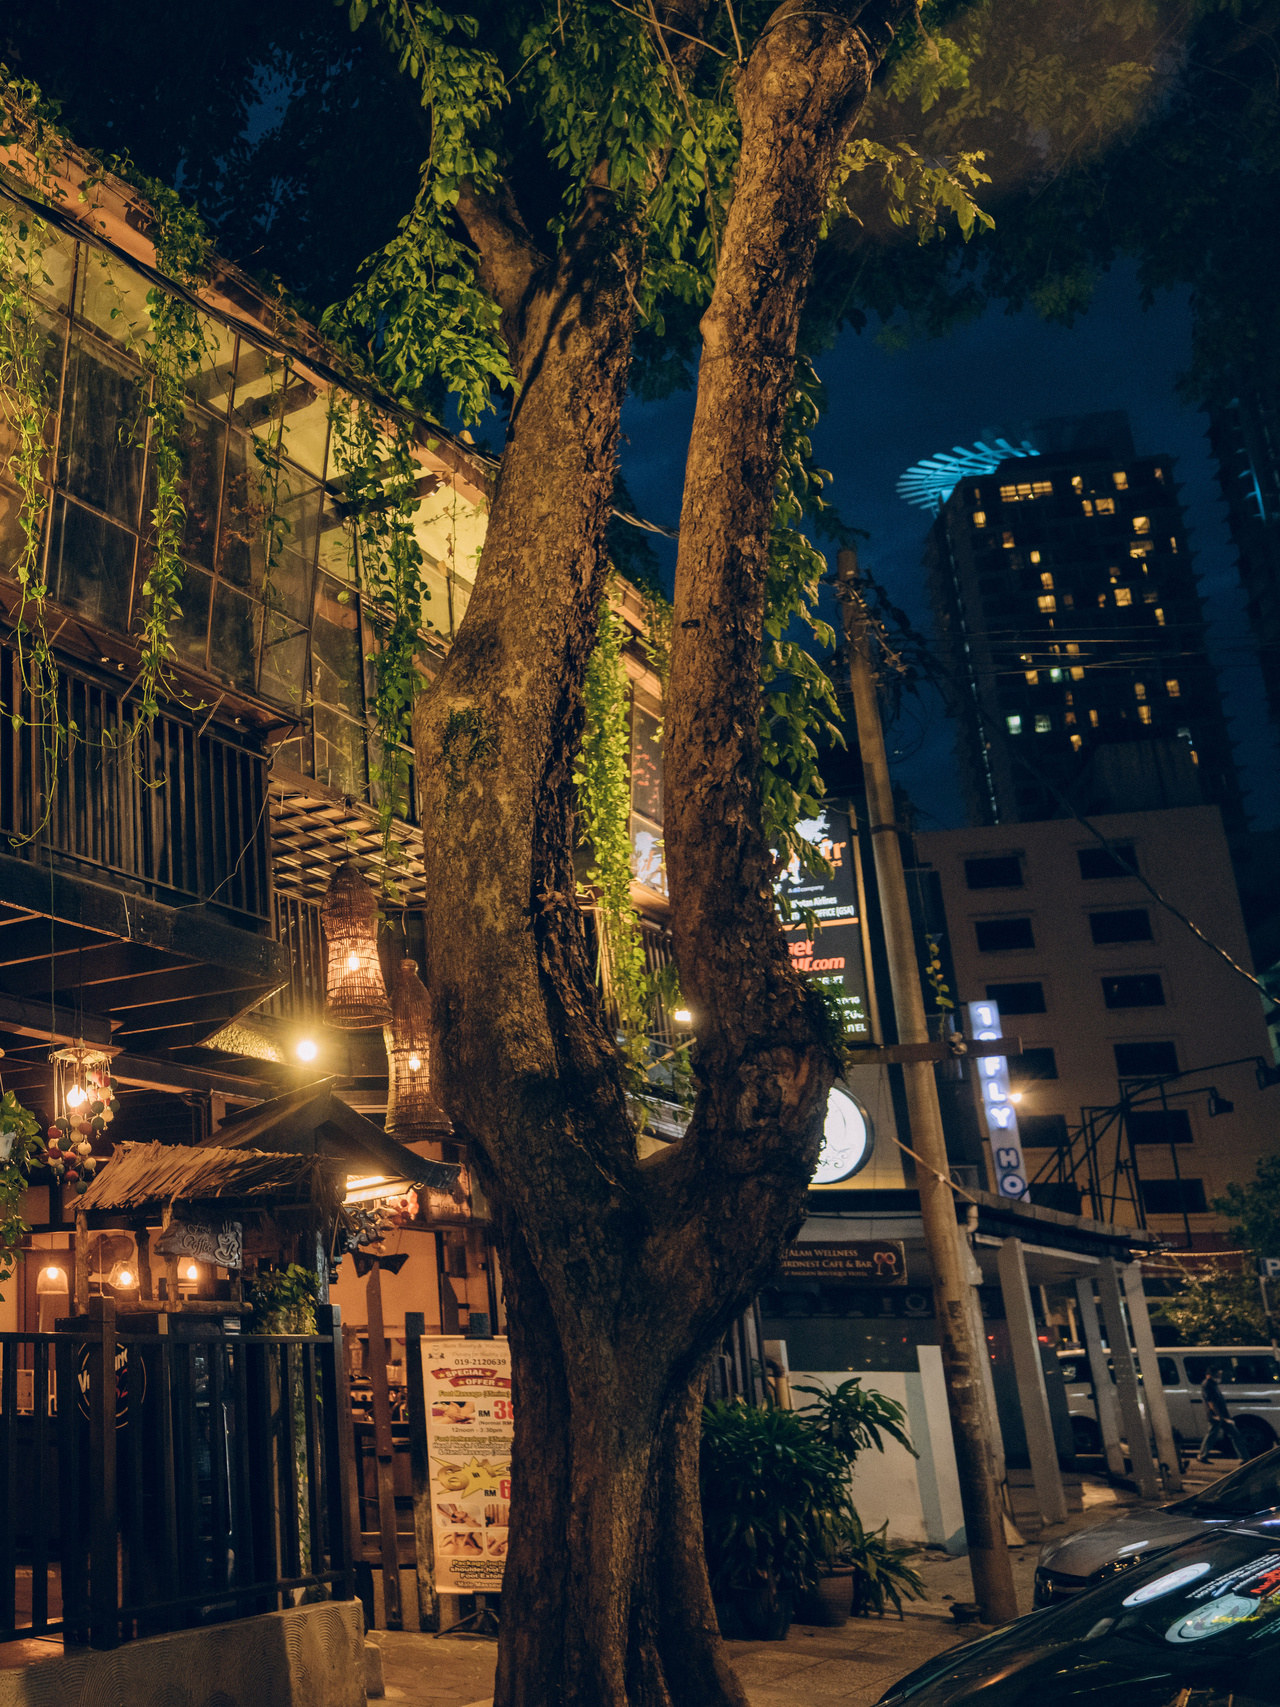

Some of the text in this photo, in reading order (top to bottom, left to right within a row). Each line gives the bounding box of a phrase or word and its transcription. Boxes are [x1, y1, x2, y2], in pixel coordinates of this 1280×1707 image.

[813, 896, 837, 906] Airlines
[836, 905, 855, 918] (GSA)
[182, 1234, 212, 1255] Coffee
[454, 1358, 507, 1366] 019-2120639
[445, 1369, 484, 1378] SPECIAL
[484, 1489, 497, 1497] RM
[452, 1559, 486, 1567] Package
